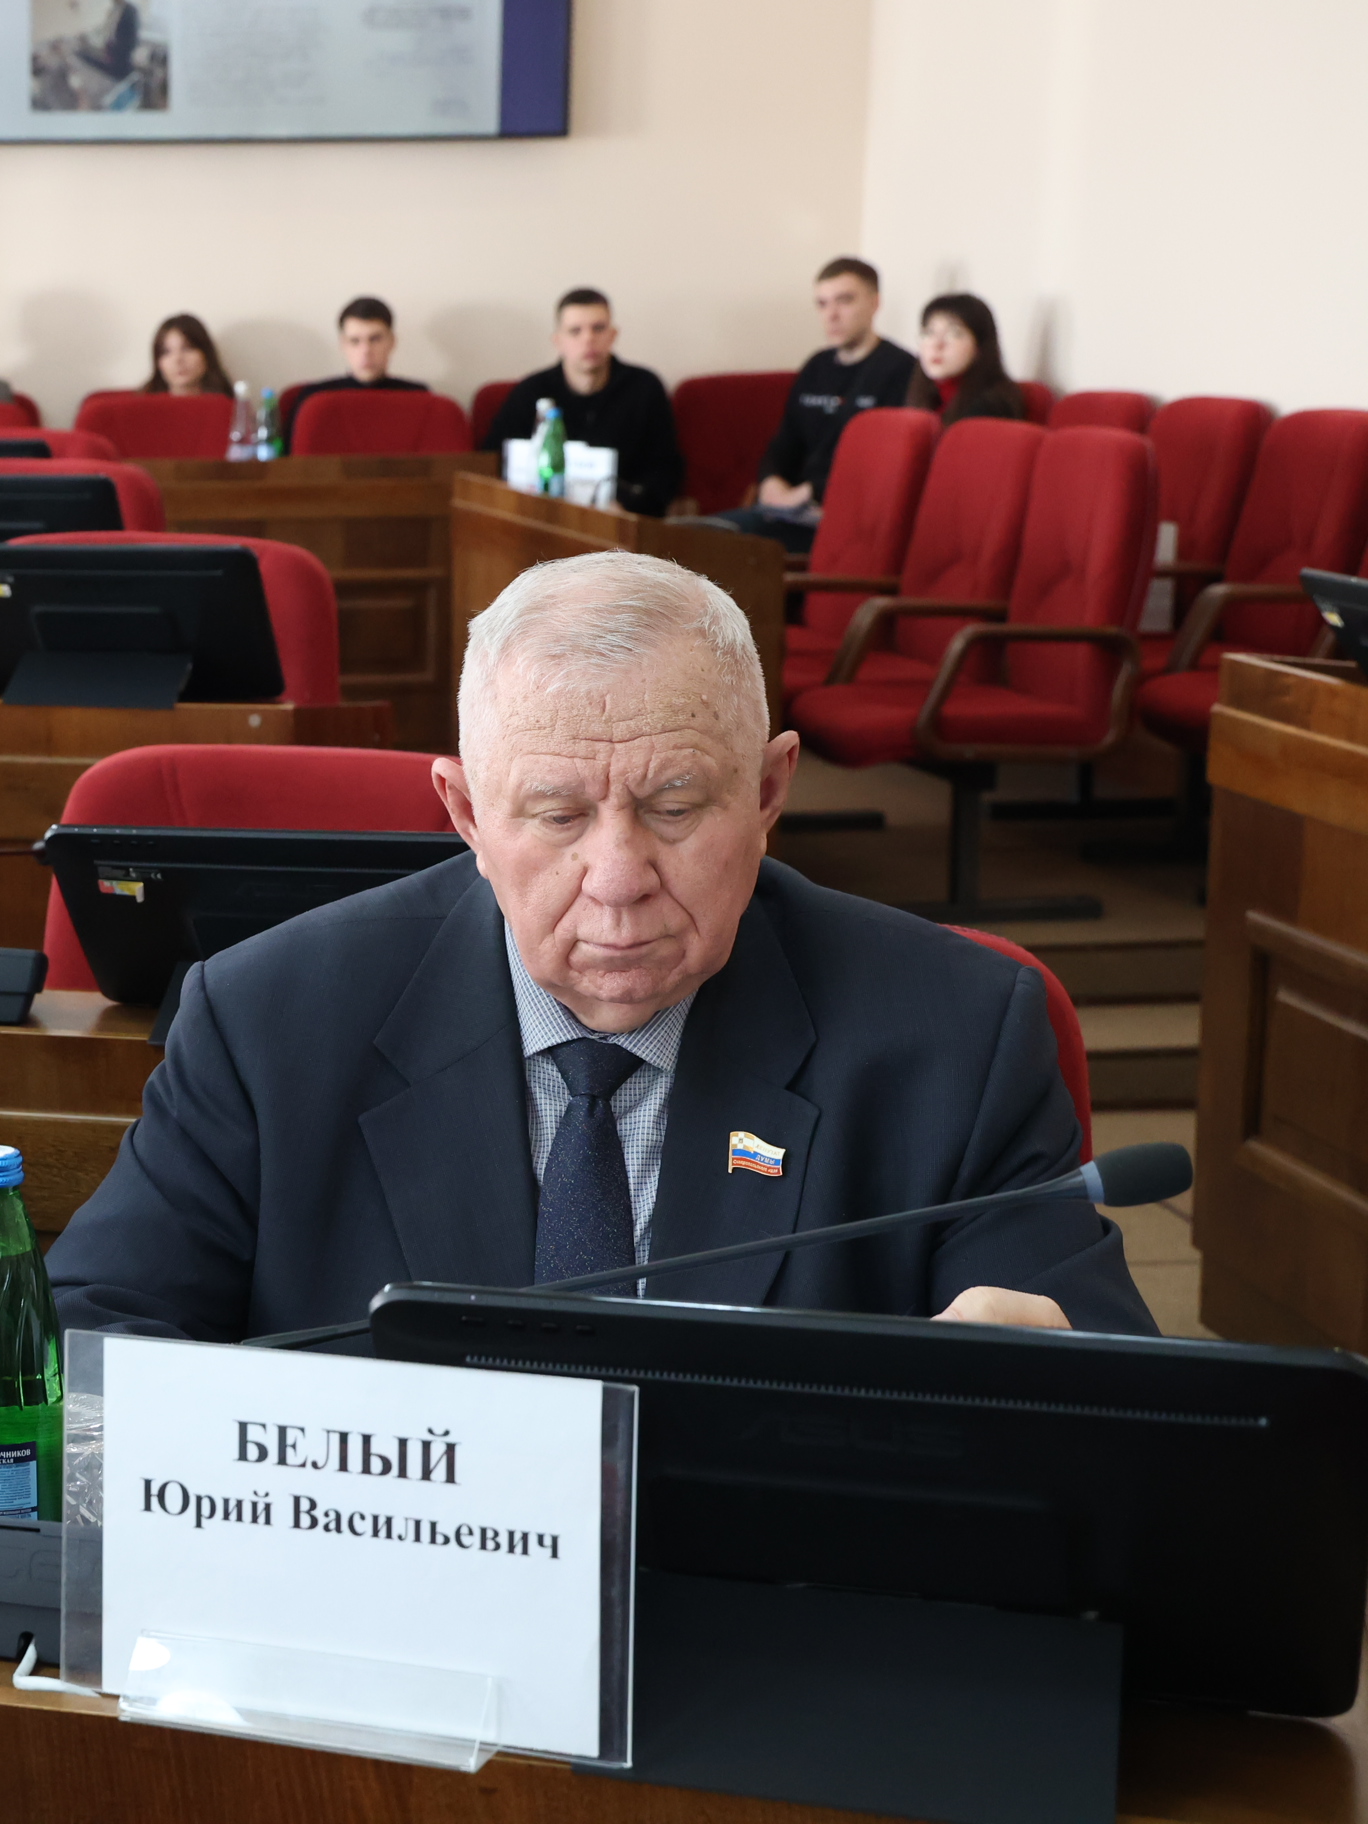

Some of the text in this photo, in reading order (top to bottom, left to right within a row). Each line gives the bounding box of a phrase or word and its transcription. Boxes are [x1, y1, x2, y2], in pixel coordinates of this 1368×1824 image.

[756, 1154, 775, 1165] ДУМЫ
[237, 1421, 457, 1484] БЕЛЫЙ
[143, 1478, 559, 1559] Юрий Васильевич
